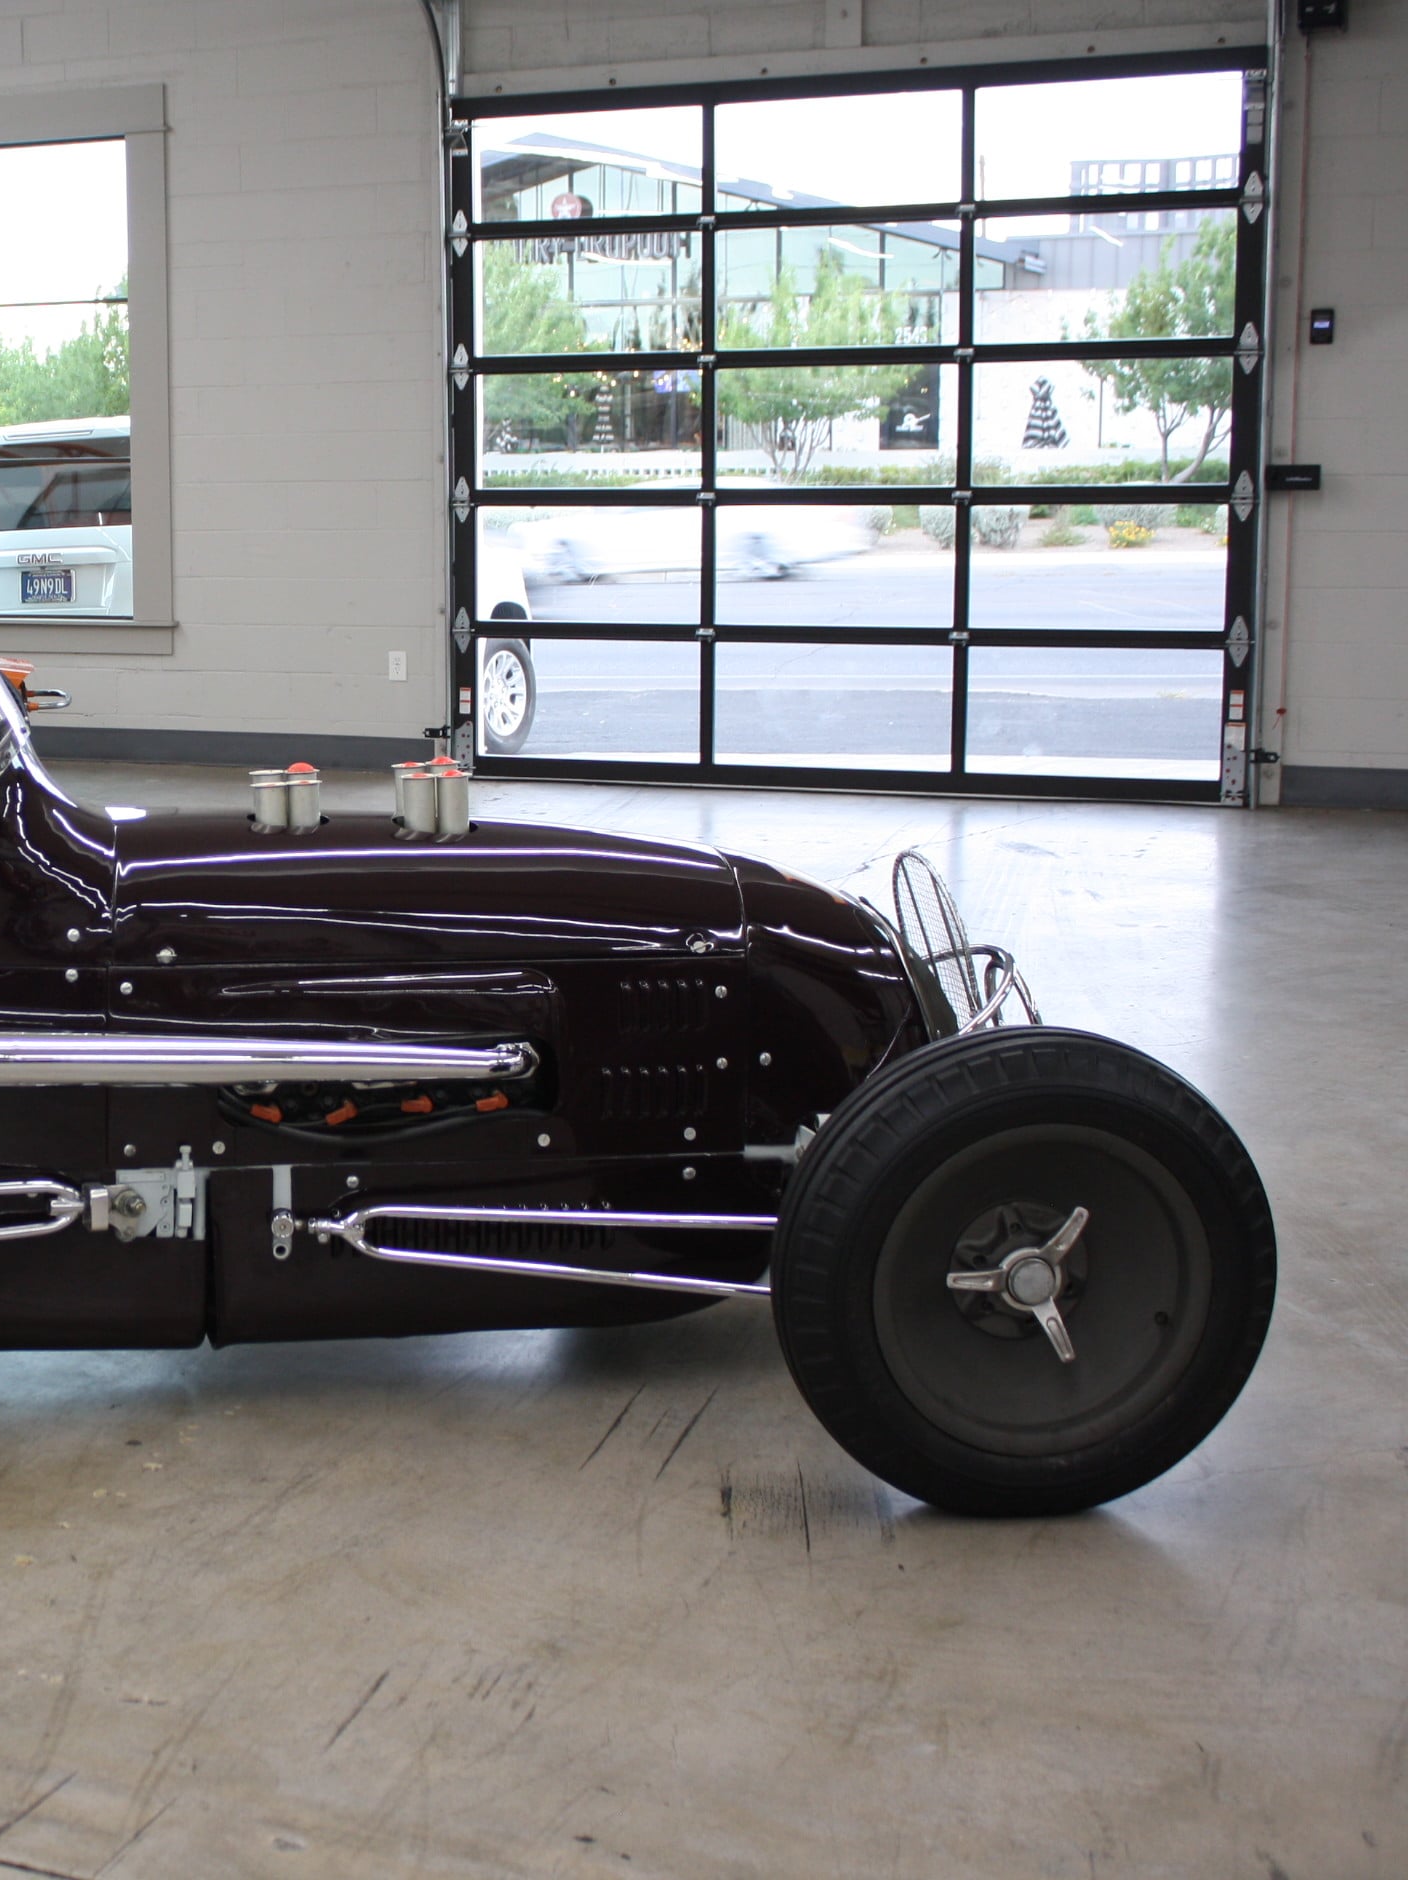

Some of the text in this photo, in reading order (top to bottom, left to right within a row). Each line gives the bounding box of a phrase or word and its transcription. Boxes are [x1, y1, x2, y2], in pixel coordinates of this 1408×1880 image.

[895, 326, 928, 345] 2543
[17, 552, 63, 565] GMC
[26, 577, 68, 595] 49N9DL
